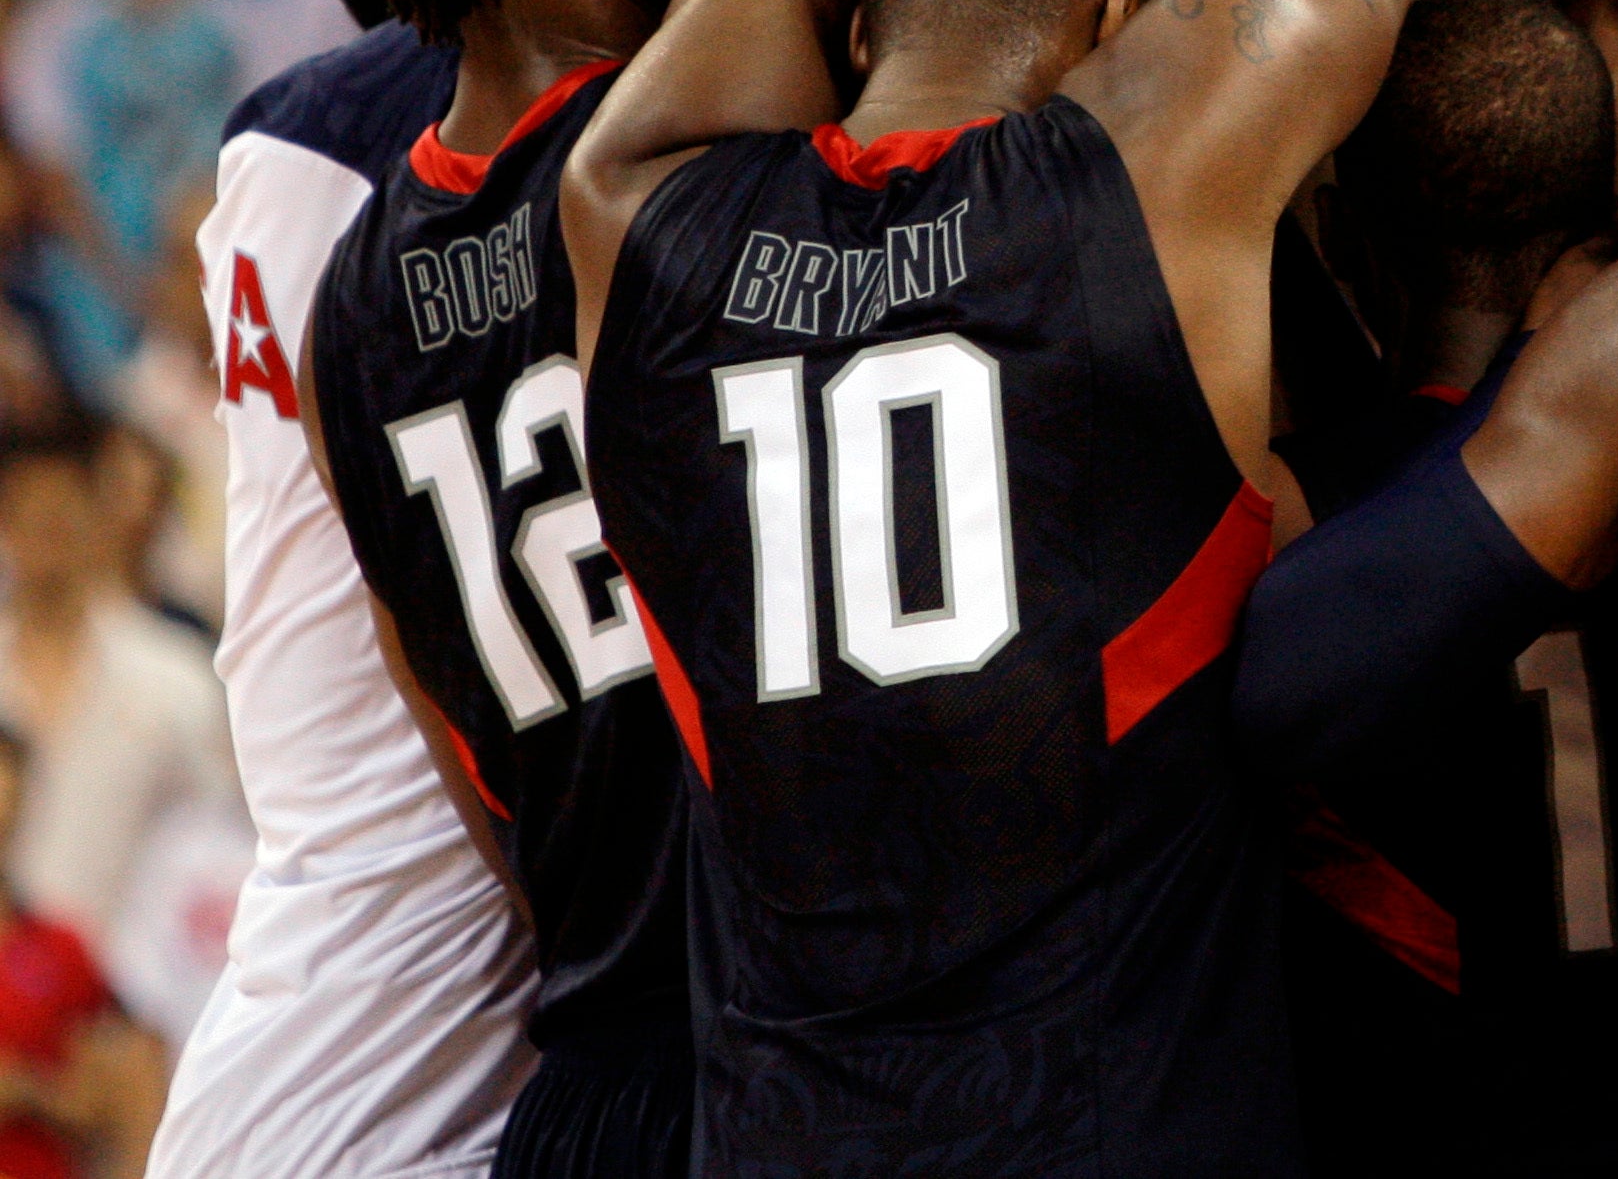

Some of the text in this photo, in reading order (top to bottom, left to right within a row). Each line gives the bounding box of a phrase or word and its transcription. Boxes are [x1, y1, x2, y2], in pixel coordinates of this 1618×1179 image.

[199, 246, 301, 423] A
[401, 202, 537, 353] BOSH
[723, 198, 969, 337] BRYANT
[384, 353, 656, 733] 12
[711, 332, 1021, 704] 10
